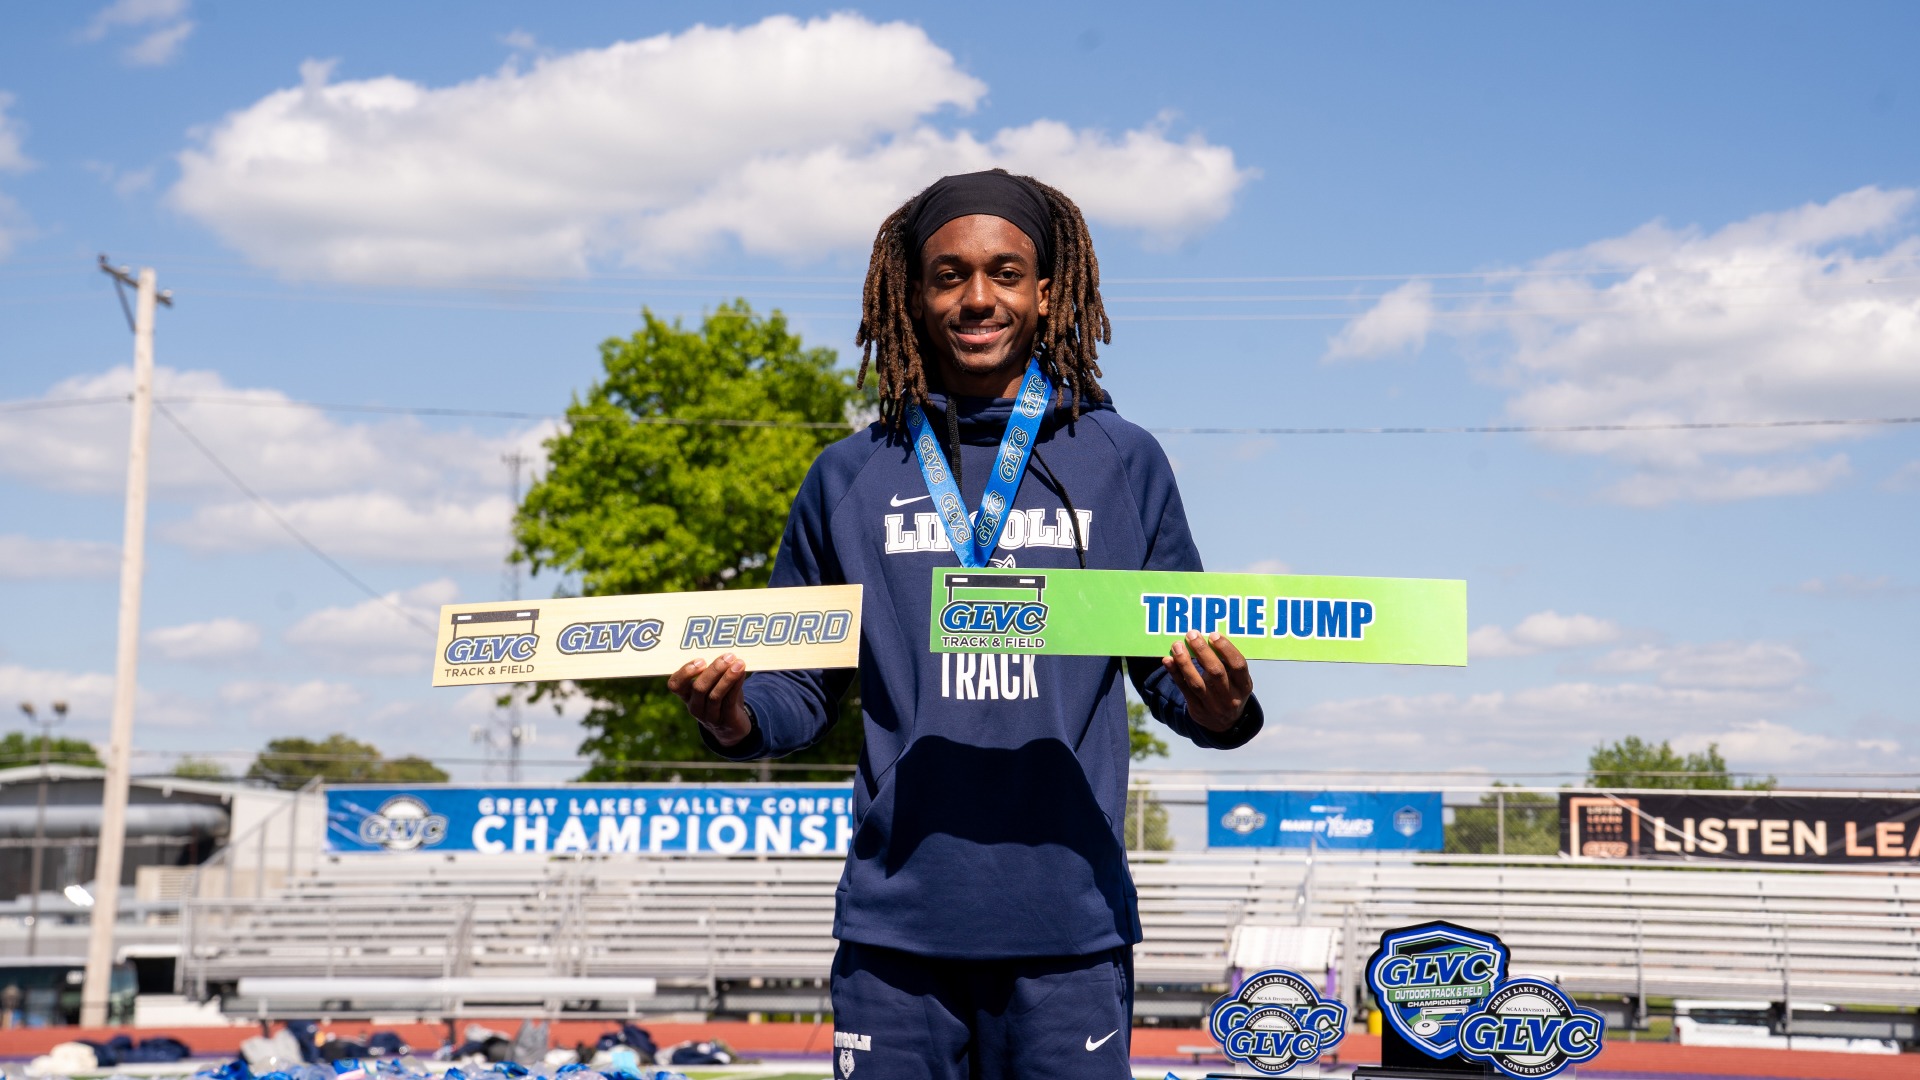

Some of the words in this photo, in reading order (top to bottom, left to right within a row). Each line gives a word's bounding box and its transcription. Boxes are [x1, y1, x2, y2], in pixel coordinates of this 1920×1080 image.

[1021, 374, 1047, 418] GLVC
[920, 435, 946, 484] GLVC
[1000, 426, 1029, 483] GLVC
[885, 508, 1092, 554] LIOLN
[940, 493, 971, 544] GLVC
[975, 490, 1006, 546] GLVC
[556, 618, 664, 655] GLVC
[680, 609, 852, 650] RECORD
[938, 600, 1050, 635] GLVC
[1142, 594, 1265, 636] TRIPLE
[1273, 598, 1374, 640] JUMP
[444, 634, 539, 665] GLVC
[942, 636, 988, 648] TRACK
[990, 637, 1002, 648] &
[1004, 637, 1045, 648] FIELD
[444, 666, 486, 678] TRACK
[488, 666, 497, 676] &
[500, 664, 535, 675] FIELD
[942, 652, 1038, 700] TRACK
[478, 797, 558, 815] GREAT
[569, 797, 647, 815] LAKES
[658, 797, 751, 815] VALLEY
[1654, 817, 1828, 856] LISTEN
[1379, 950, 1496, 988] GLVC
[1243, 980, 1262, 1000] GREAT
[1264, 976, 1288, 984] LAKES
[1290, 980, 1314, 1001] VALLEY
[1395, 989, 1430, 1000] OUTDOOR
[1431, 988, 1456, 998] TRACK
[1456, 988, 1462, 996] &
[1463, 986, 1482, 996] FIELD
[1408, 998, 1471, 1008] CHAMPIONSHIP
[1490, 990, 1512, 1010] GREAT
[1512, 986, 1538, 994] LAKES
[1541, 990, 1567, 1012] VALLEY
[1248, 1013, 1262, 1026] GREAT
[1280, 1013, 1298, 1028] VALLEY
[1460, 1013, 1599, 1057] GLVC
[1226, 1029, 1320, 1058] GLVC
[1254, 1059, 1290, 1071] CONFERENCE
[1502, 1059, 1556, 1074] CONFERENCE
